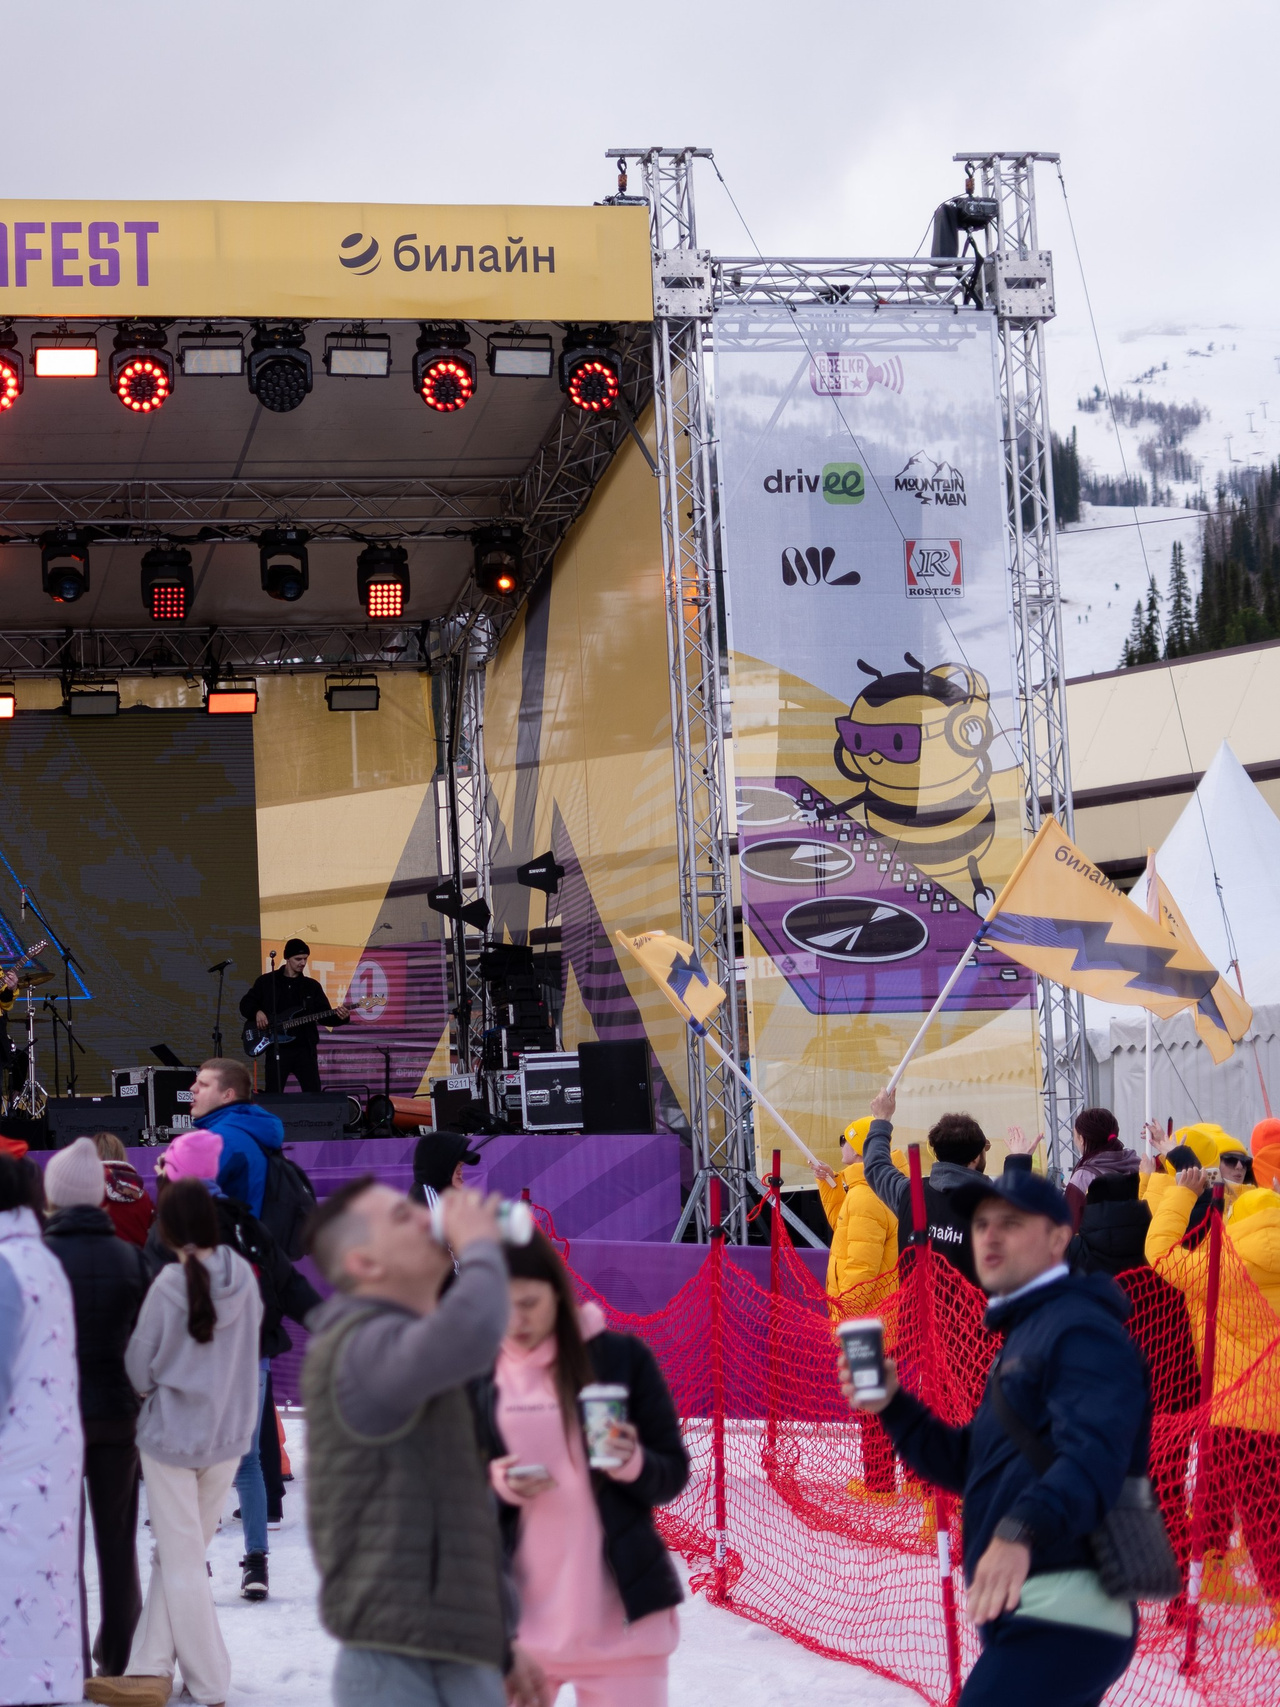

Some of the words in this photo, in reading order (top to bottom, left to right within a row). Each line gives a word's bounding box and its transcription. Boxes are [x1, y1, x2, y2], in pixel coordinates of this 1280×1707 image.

[394, 233, 555, 273] билайн
[819, 358, 864, 373] GRELKA
[820, 375, 850, 389] FEST
[763, 468, 864, 497] drivee
[934, 493, 967, 507] MAN
[908, 588, 962, 596] ROSTIC'S
[121, 1086, 138, 1095] S250
[448, 1080, 467, 1089] S211
[928, 1225, 963, 1244] лайн
